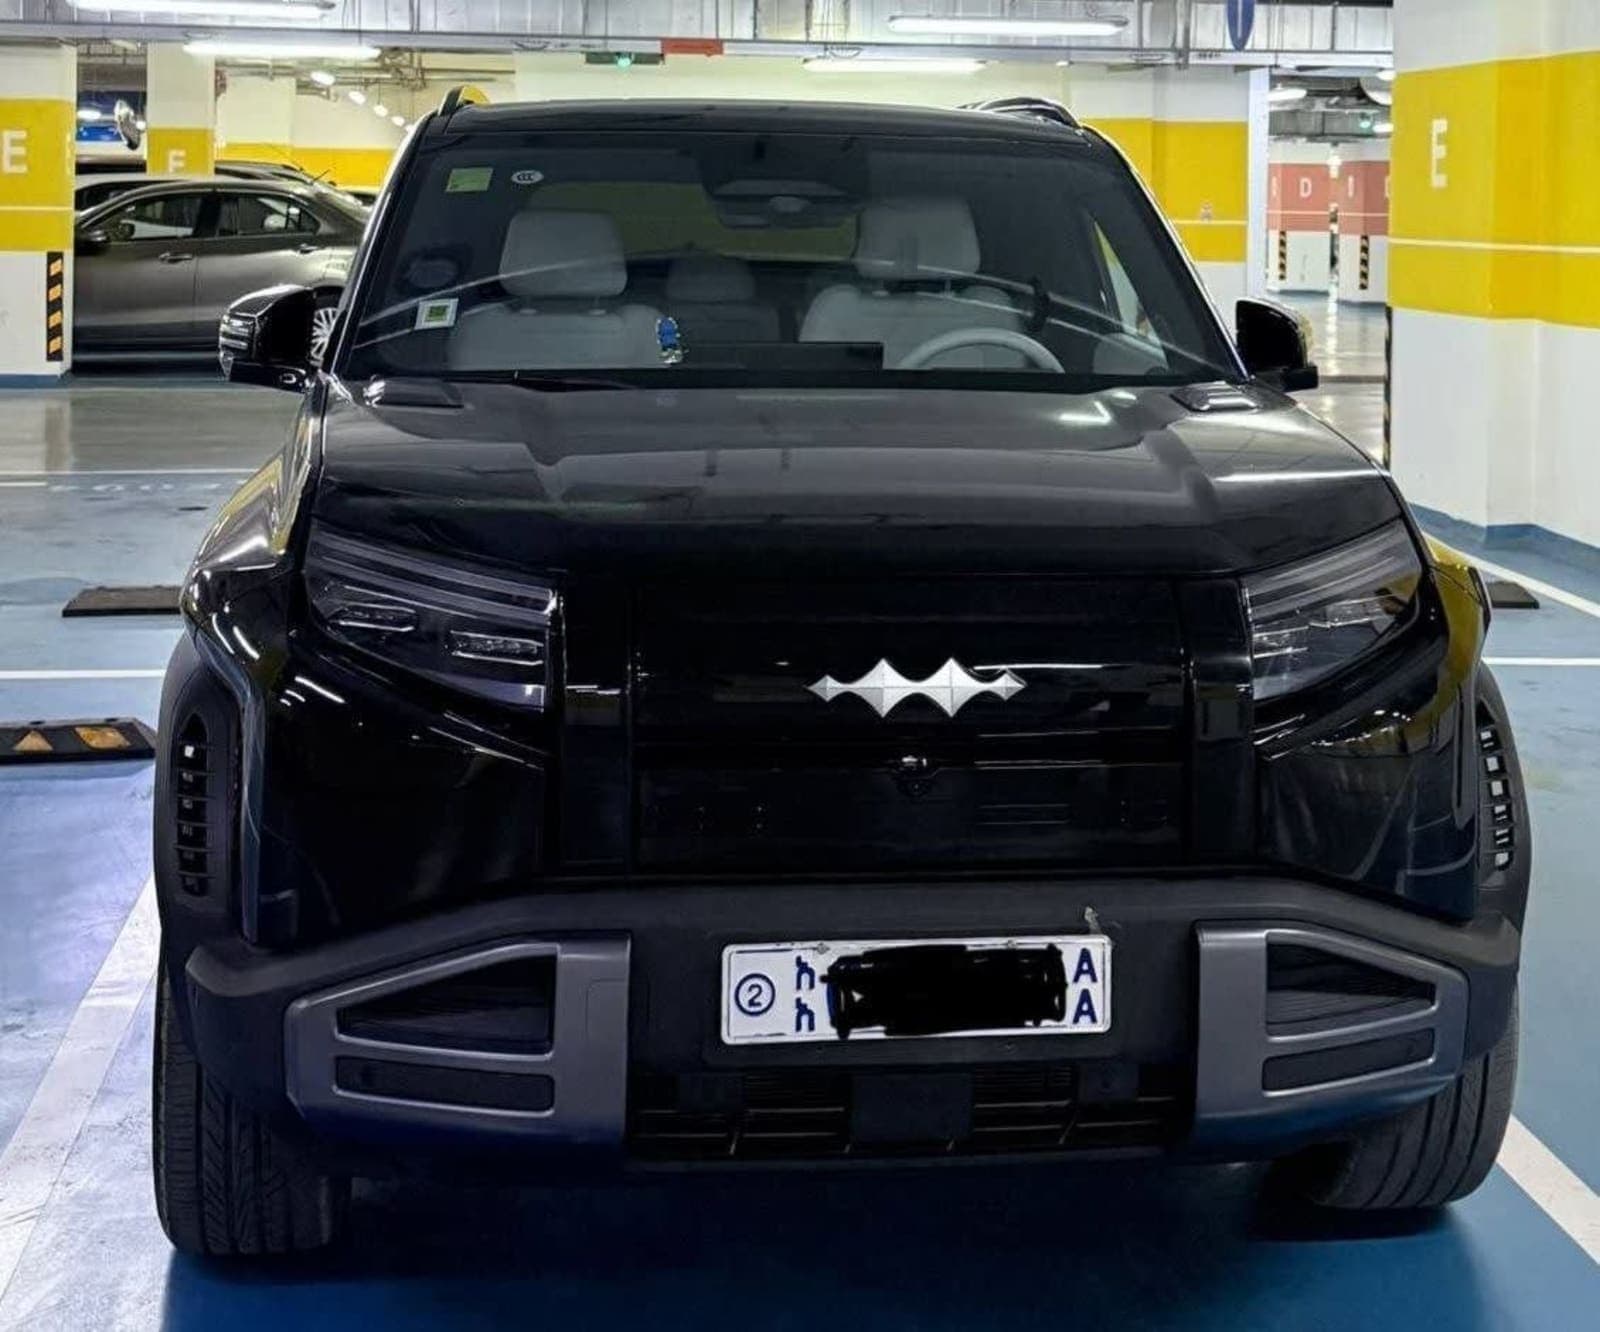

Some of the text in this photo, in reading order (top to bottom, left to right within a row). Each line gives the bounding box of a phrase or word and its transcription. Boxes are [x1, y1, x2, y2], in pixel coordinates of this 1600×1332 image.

[2, 129, 28, 174] E
[1430, 118, 1449, 189] E
[1299, 178, 1312, 198] D
